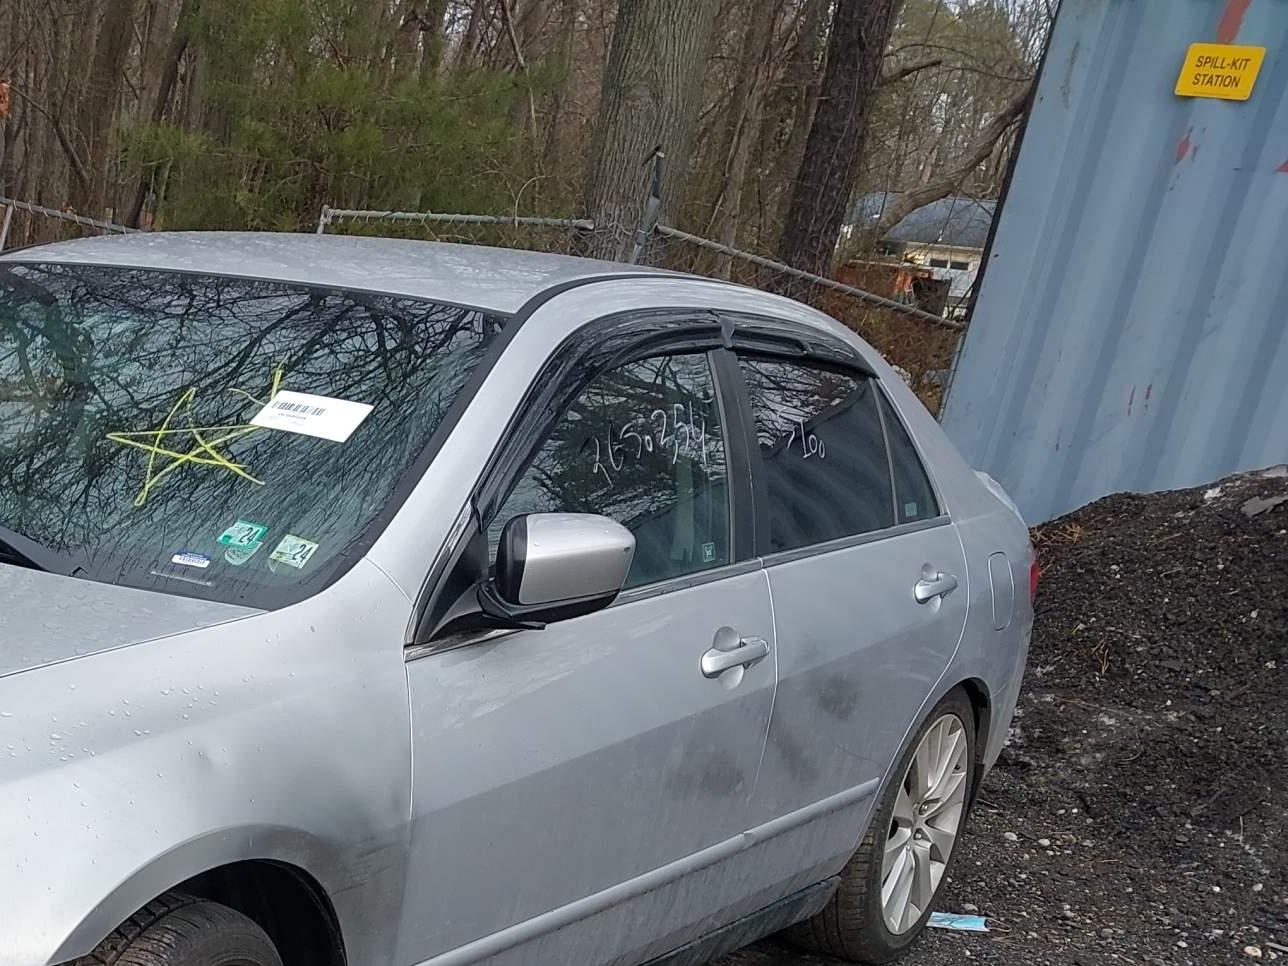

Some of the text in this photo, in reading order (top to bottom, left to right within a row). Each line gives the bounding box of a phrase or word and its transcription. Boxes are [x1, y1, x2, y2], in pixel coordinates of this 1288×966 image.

[1195, 56, 1251, 71] SPILL-KIT
[1192, 72, 1241, 88] STATION
[239, 526, 260, 545] 24
[291, 543, 314, 562] 24
